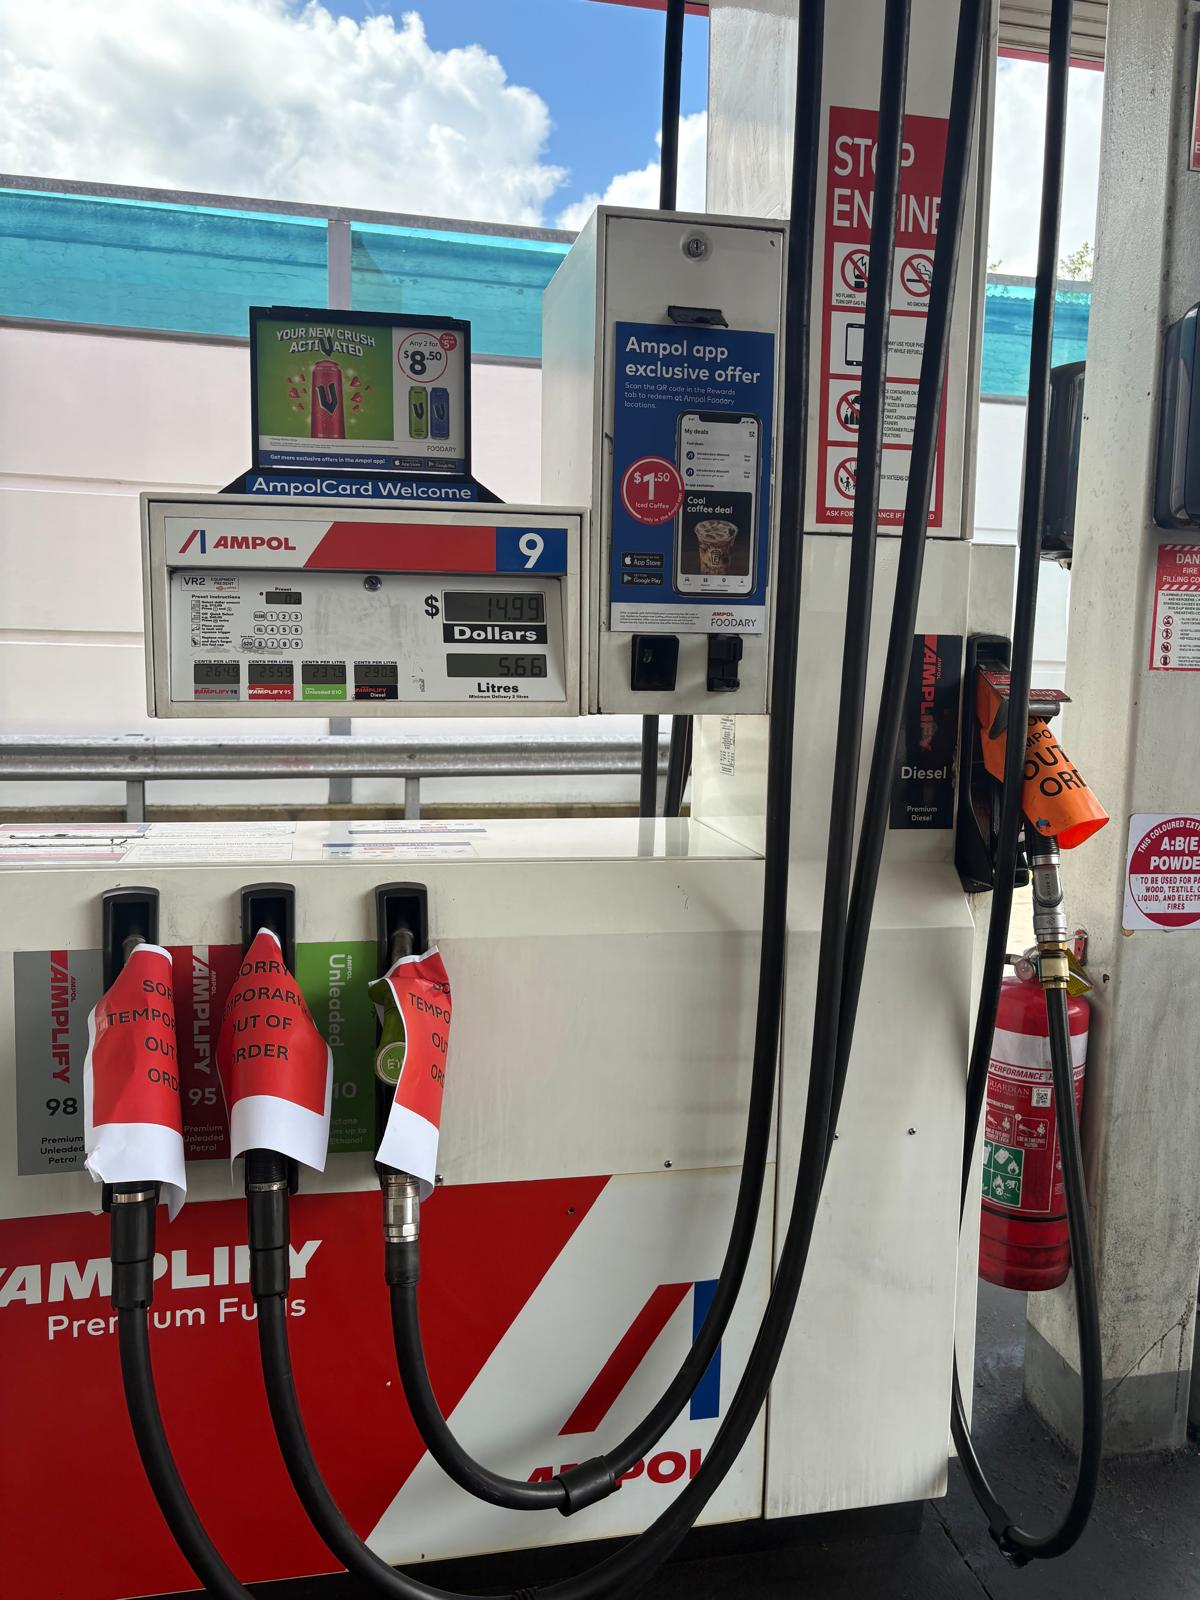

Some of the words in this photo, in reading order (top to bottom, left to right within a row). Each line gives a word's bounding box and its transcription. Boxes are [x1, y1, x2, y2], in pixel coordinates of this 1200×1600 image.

[834, 136, 914, 177] STP
[833, 188, 942, 234] ENINE
[276, 328, 306, 340] YOUR
[309, 328, 334, 338] NEW
[337, 330, 376, 346] CRUSH
[626, 336, 687, 358] Ampol
[693, 346, 728, 362] app
[404, 350, 442, 375] $8.50
[626, 361, 710, 381] exclusive
[714, 366, 760, 384] offer
[706, 397, 735, 405] Foodary
[252, 477, 372, 496] AmpolCard
[378, 482, 472, 499] Welcome
[634, 472, 670, 500] $1.50
[687, 496, 706, 505] Cool
[687, 505, 713, 514] coffee
[715, 506, 733, 514] deal
[212, 536, 296, 550] AMPOL
[518, 532, 544, 568] 9
[184, 577, 206, 586] VR2
[424, 594, 440, 619] $
[711, 618, 756, 627] FOODARY
[454, 626, 537, 642] Dollars
[477, 682, 519, 693] Litres
[901, 766, 947, 780] Diesel
[1138, 839, 1151, 853] THIS
[1150, 820, 1184, 839] COLOURED
[1160, 836, 1200, 854] A:B(E
[1138, 894, 1160, 903] LIQUID,
[1145, 886, 1165, 894] WOOD,
[240, 960, 289, 976] ORRY
[143, 980, 174, 1000] SOR
[329, 954, 346, 1047] Unleaded
[50, 966, 70, 1084] AMPLIFY
[108, 1008, 176, 1032] TEMPOR
[192, 960, 211, 1074] AMPLIFY
[265, 1015, 292, 1030] OF
[145, 1037, 175, 1060] OUT
[148, 1068, 178, 1092] ORD
[990, 1062, 1044, 1080] PERFORMANCE
[188, 1088, 217, 1105] 95
[46, 1098, 78, 1116] 98
[41, 1135, 84, 1145] Premium
[184, 1134, 224, 1142] Unleaded
[41, 1145, 84, 1154] Unleaded
[48, 1156, 77, 1165] Petrol
[48, 1306, 205, 1340] Preum
[220, 1297, 306, 1324] Fus
